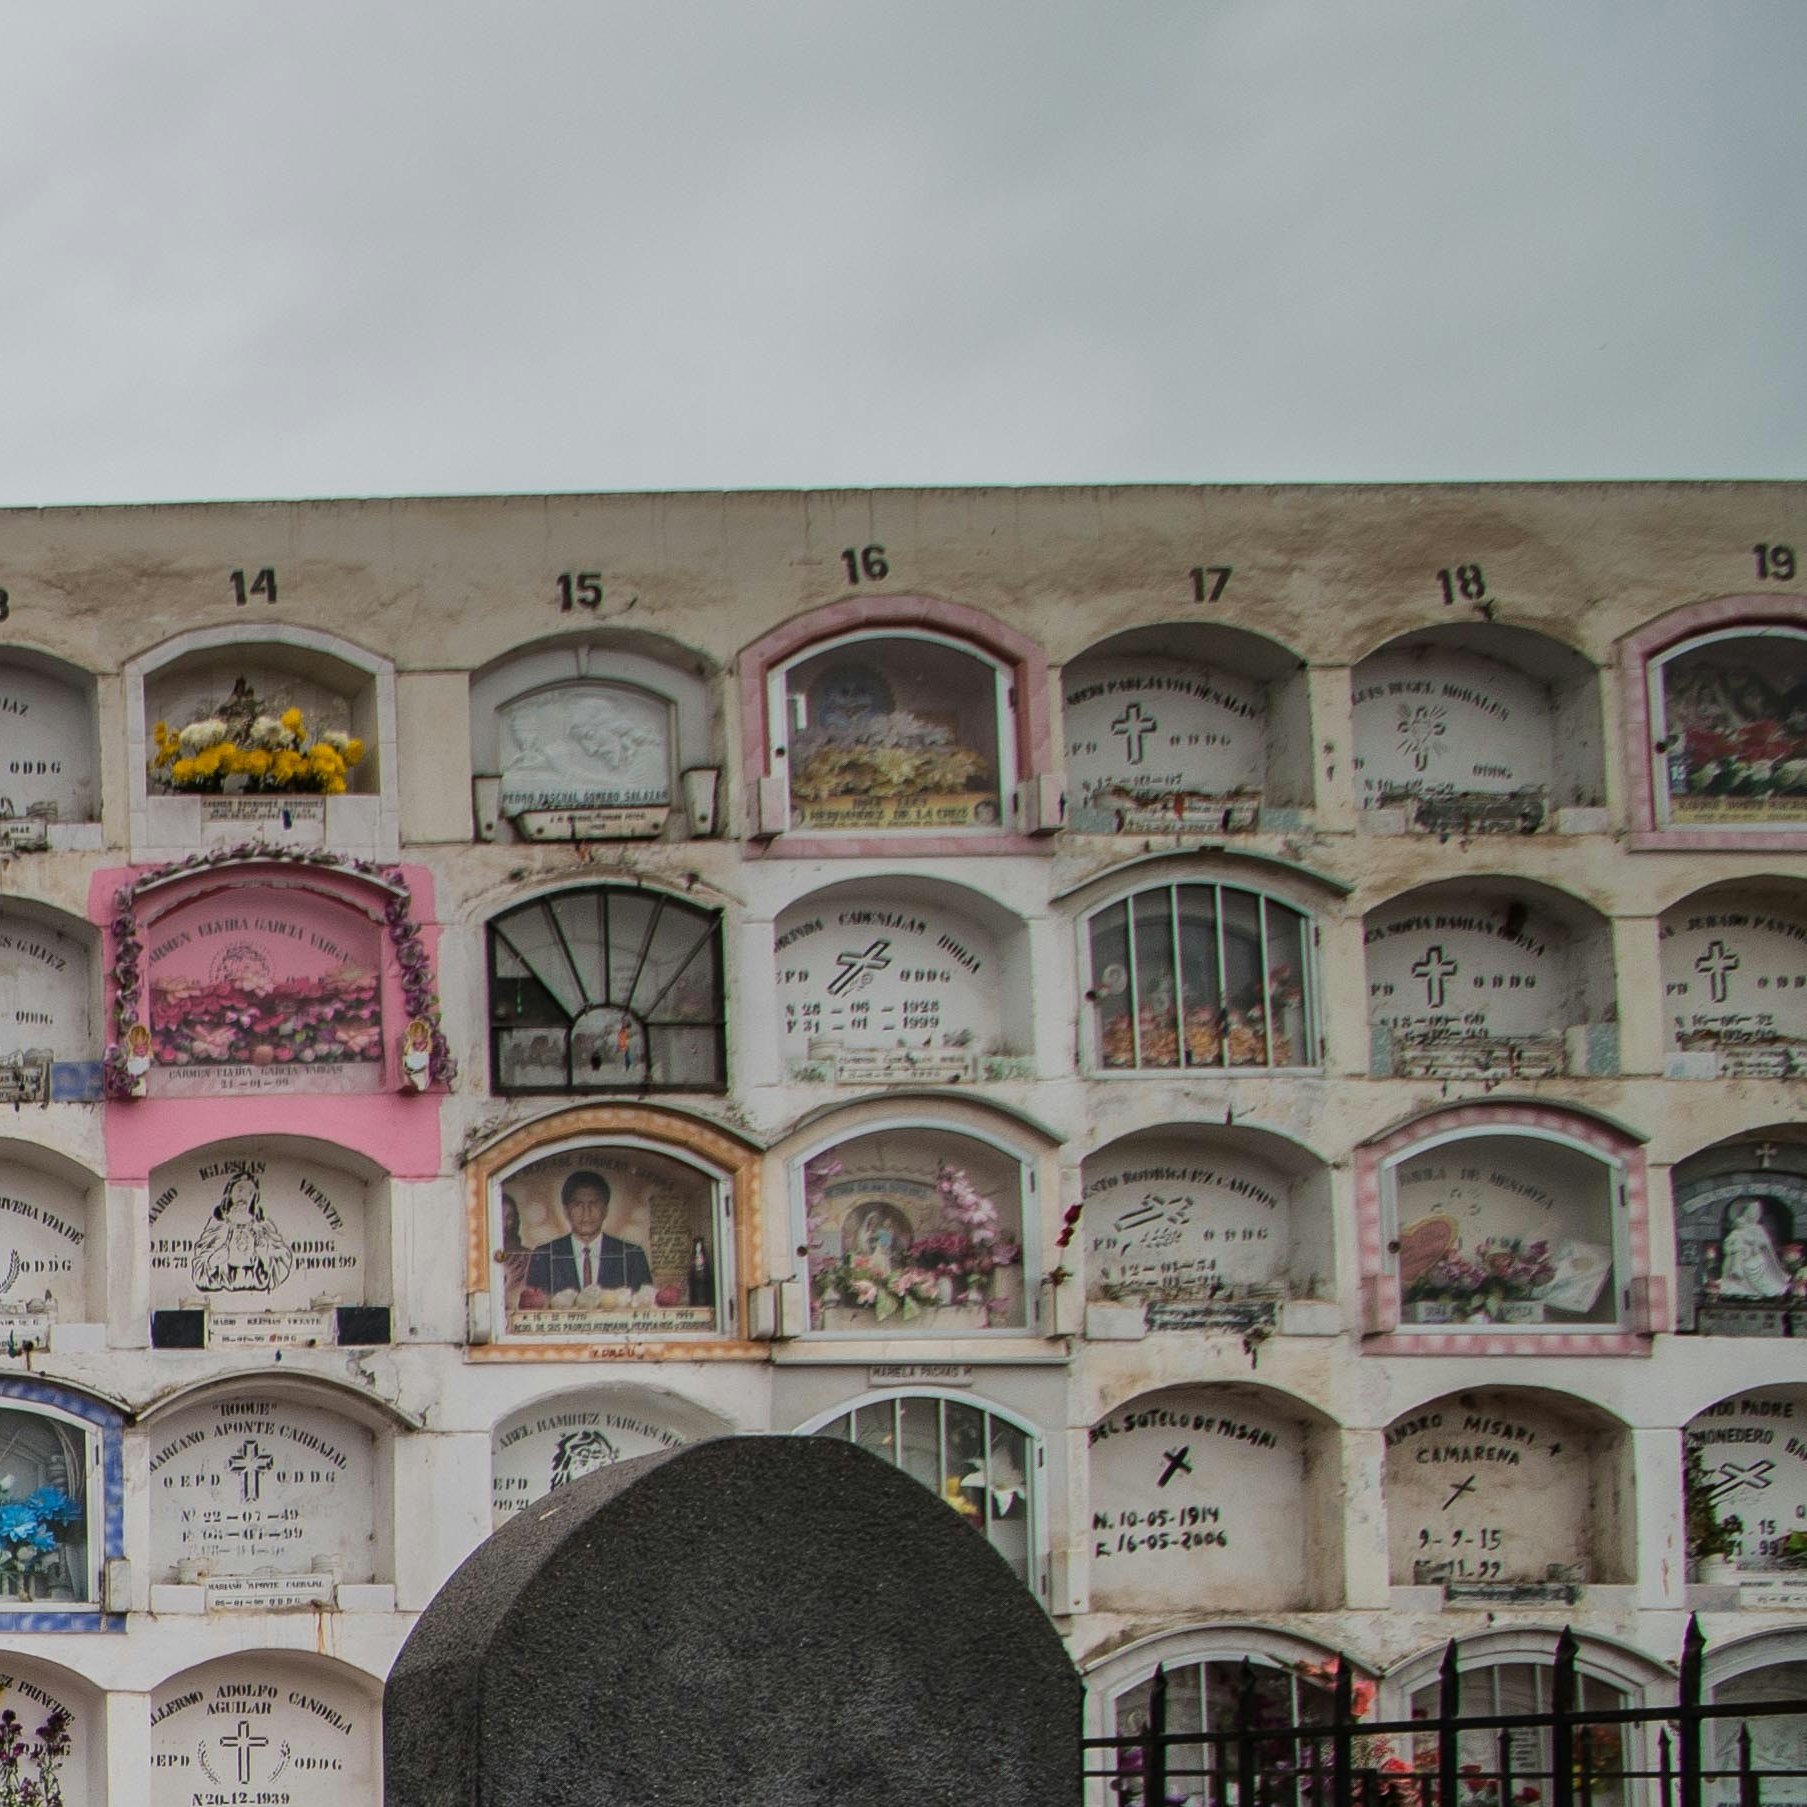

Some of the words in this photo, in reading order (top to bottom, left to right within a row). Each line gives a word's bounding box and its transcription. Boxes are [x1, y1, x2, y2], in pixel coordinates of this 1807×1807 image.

[841, 544, 890, 585] 16
[1753, 543, 1796, 581] 19
[229, 568, 278, 606] 14
[556, 571, 603, 612] 15
[1189, 566, 1233, 603] 17
[1437, 563, 1486, 605] 18
[213, 1420, 275, 1438] APONTE
[1193, 1415, 1214, 1433] DE
[17, 1680, 76, 1727] PRINCIPE
[206, 1701, 272, 1715] AGUILAR
[216, 1684, 278, 1700] ADOLFO
[288, 1691, 353, 1736] CANDELA
